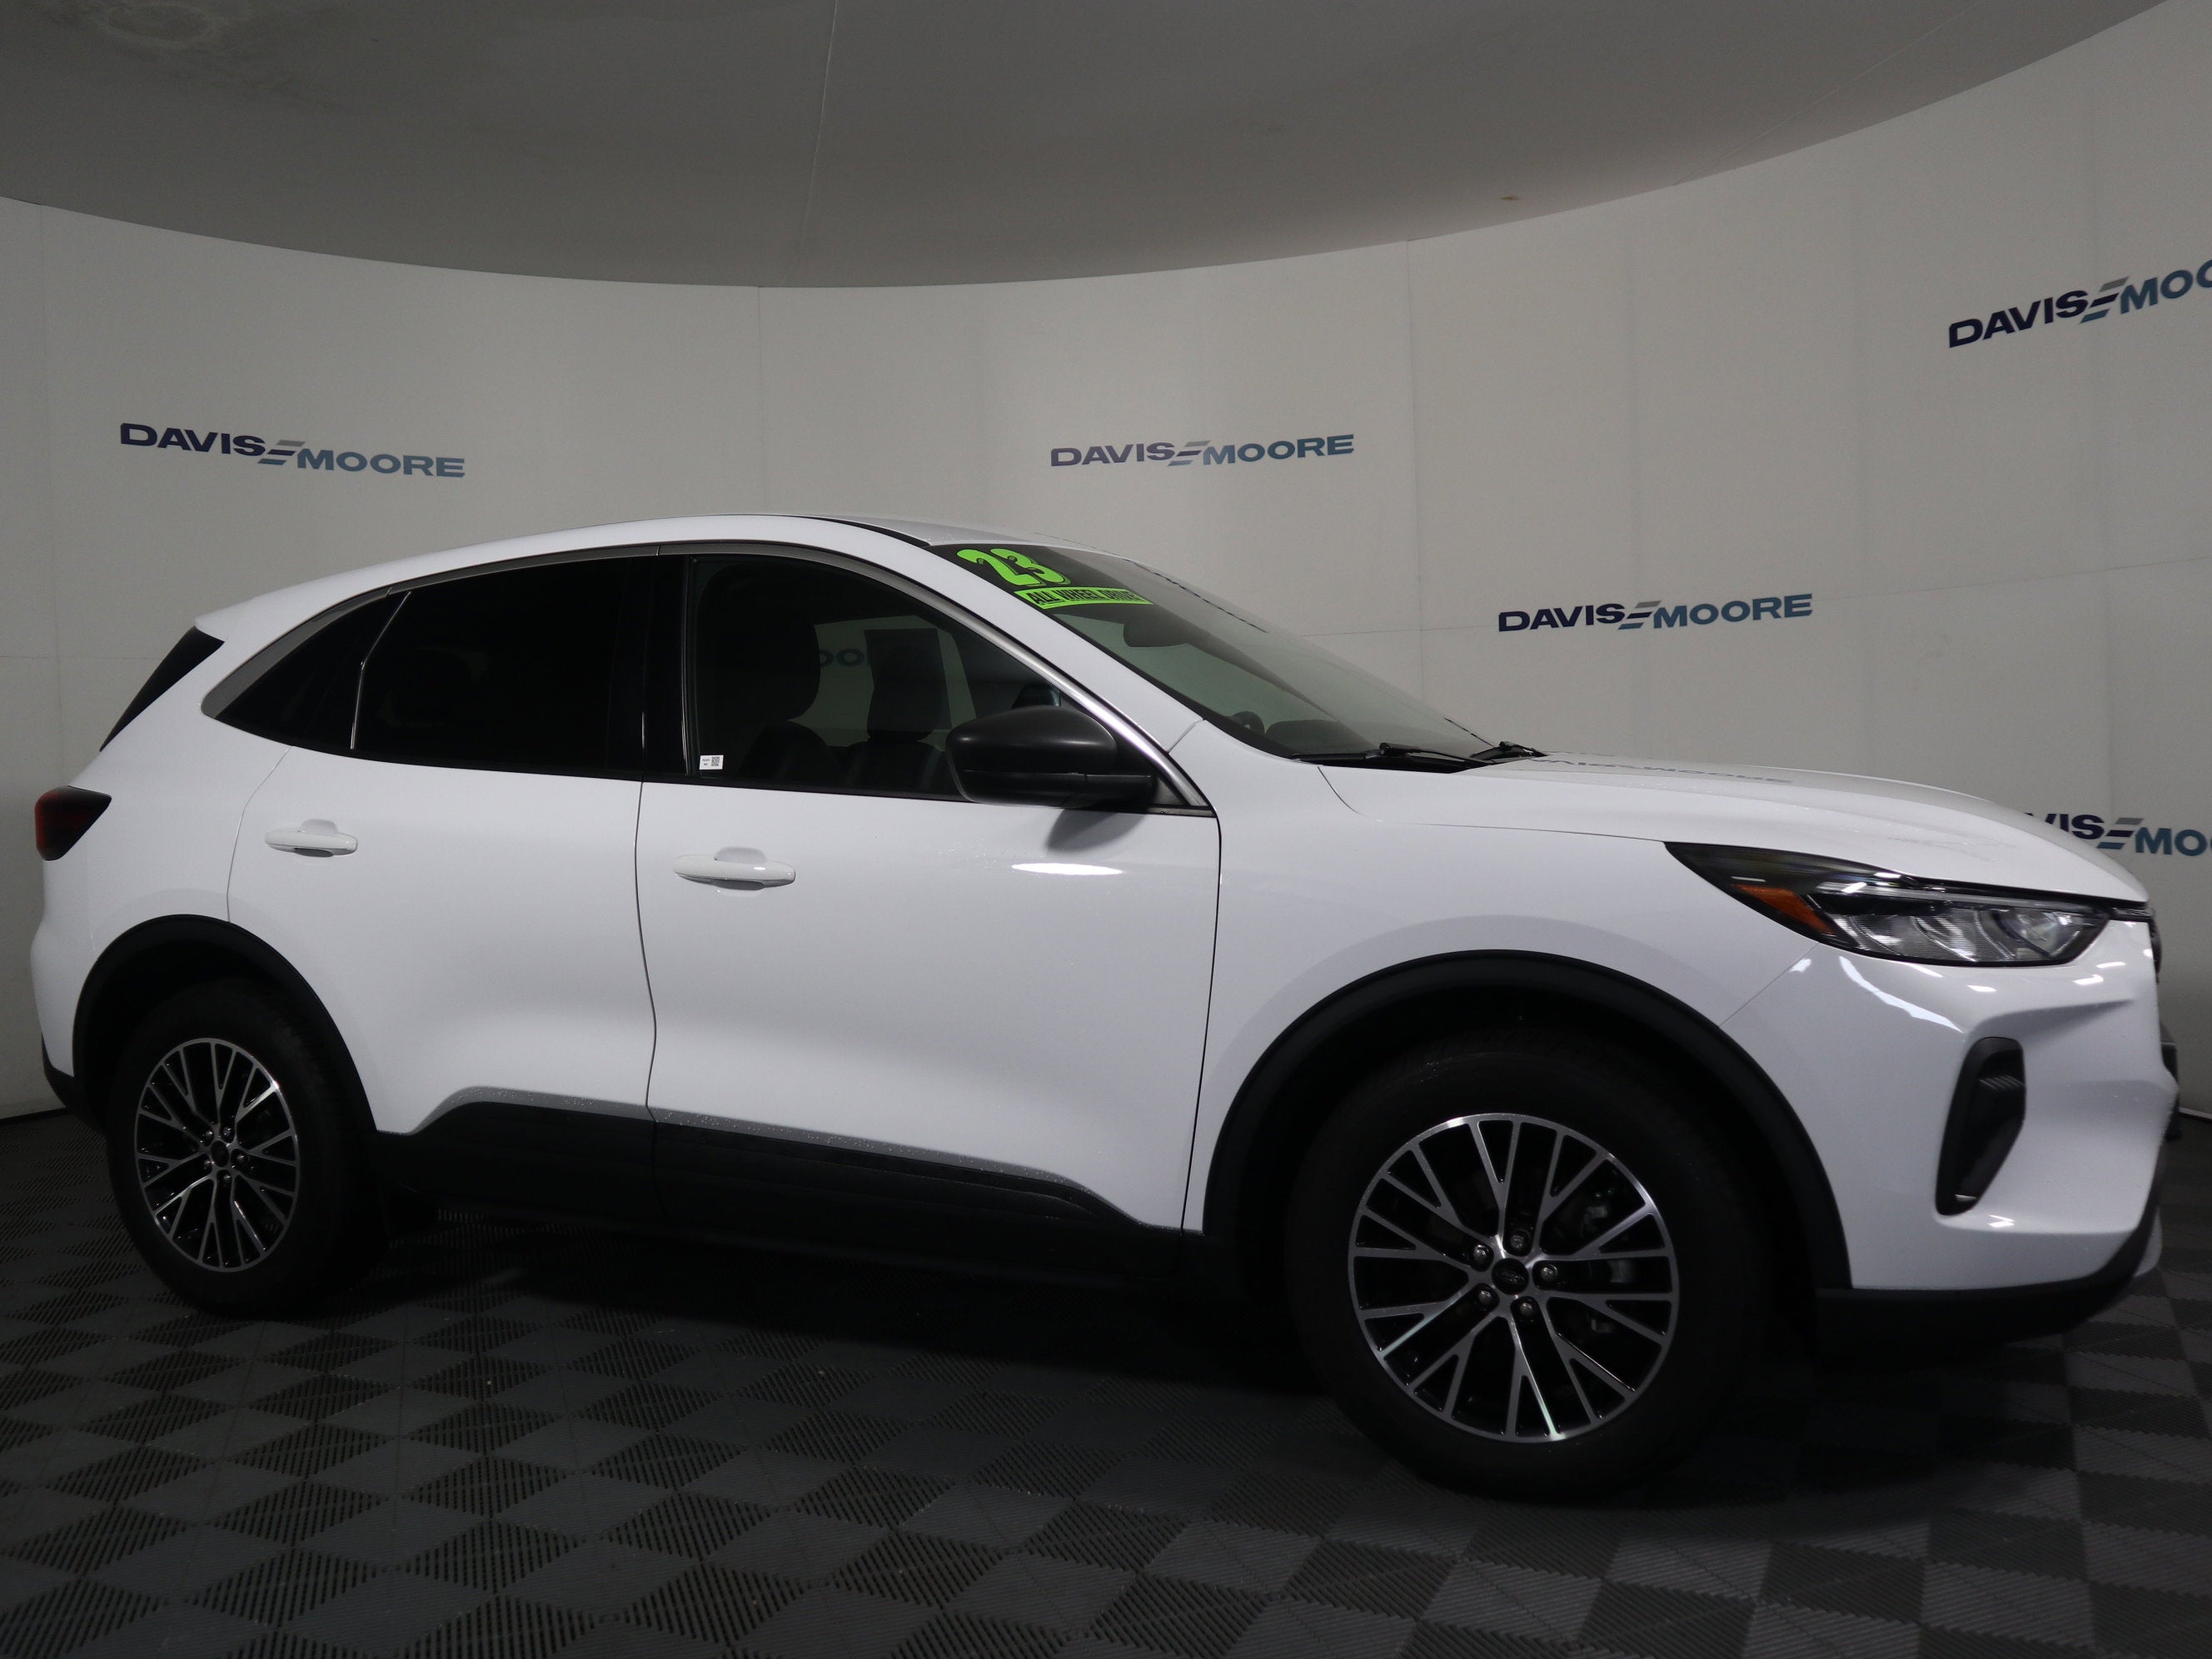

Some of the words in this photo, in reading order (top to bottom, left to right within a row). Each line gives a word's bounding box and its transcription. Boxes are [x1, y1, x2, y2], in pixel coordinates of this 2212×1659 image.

[1949, 290, 2089, 348] DAVIS
[120, 422, 266, 456] DAVIS
[296, 447, 466, 478] MOORE
[1050, 441, 1176, 467] DAVIS
[1202, 434, 1354, 466] MOORE
[956, 548, 1067, 586] 23
[1026, 590, 1063, 605] ALL
[1052, 589, 1108, 600] WHEEL
[1498, 602, 1626, 632] DAVIS
[1653, 593, 1813, 629] MOORE
[2135, 826, 2212, 857] MO
